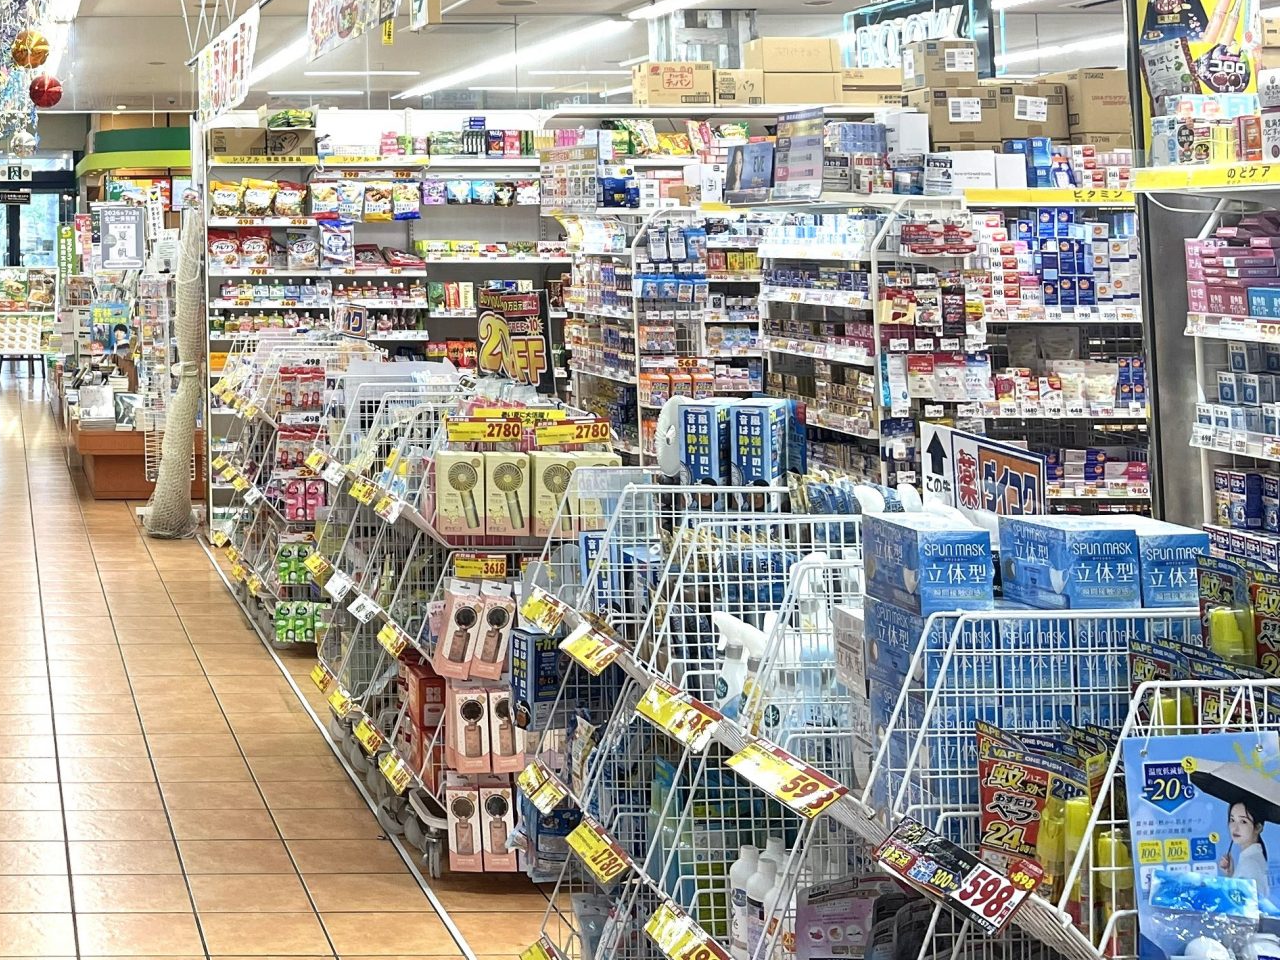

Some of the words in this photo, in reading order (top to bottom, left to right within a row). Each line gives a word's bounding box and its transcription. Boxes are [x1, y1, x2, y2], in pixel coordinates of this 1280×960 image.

[1209, 59, 1246, 74] コロロ
[1227, 166, 1270, 179] のどケア
[1073, 190, 1122, 198] ビタミン
[677, 359, 698, 367] 568
[487, 423, 520, 438] 2780
[575, 423, 609, 439] 2780
[686, 414, 697, 465] 音は静か！
[698, 414, 709, 475] 風は強いのに
[738, 414, 749, 466] 音は静か！
[750, 414, 762, 476] 風は強いのに
[957, 448, 980, 509] 薬
[982, 459, 1039, 516] ダイコク
[924, 543, 953, 556] SPUN
[955, 543, 986, 556] MASK
[1013, 539, 1049, 566] 立体型
[1073, 542, 1101, 555] SPUN
[1103, 542, 1133, 555] MASK
[1146, 548, 1173, 561] SPUN
[1176, 546, 1205, 560] MASK
[483, 562, 505, 575] 3618
[1197, 556, 1217, 568] VAPE
[925, 563, 988, 584] 立体型
[1075, 562, 1135, 583] 立体型
[1253, 570, 1278, 583] VAPE
[1130, 641, 1153, 655] VAPE
[1193, 662, 1212, 675] VAPE
[1022, 737, 1035, 745] ONE
[1036, 740, 1054, 748] PUSH
[992, 748, 1023, 760] VAPE
[1024, 755, 1040, 765] ONE
[1041, 758, 1062, 771] PUSH
[992, 762, 1025, 790] 蚊
[994, 793, 1035, 809] おすだけ
[989, 801, 1038, 821] ベープ
[987, 822, 1022, 851] 24
[958, 869, 1015, 918] 598
